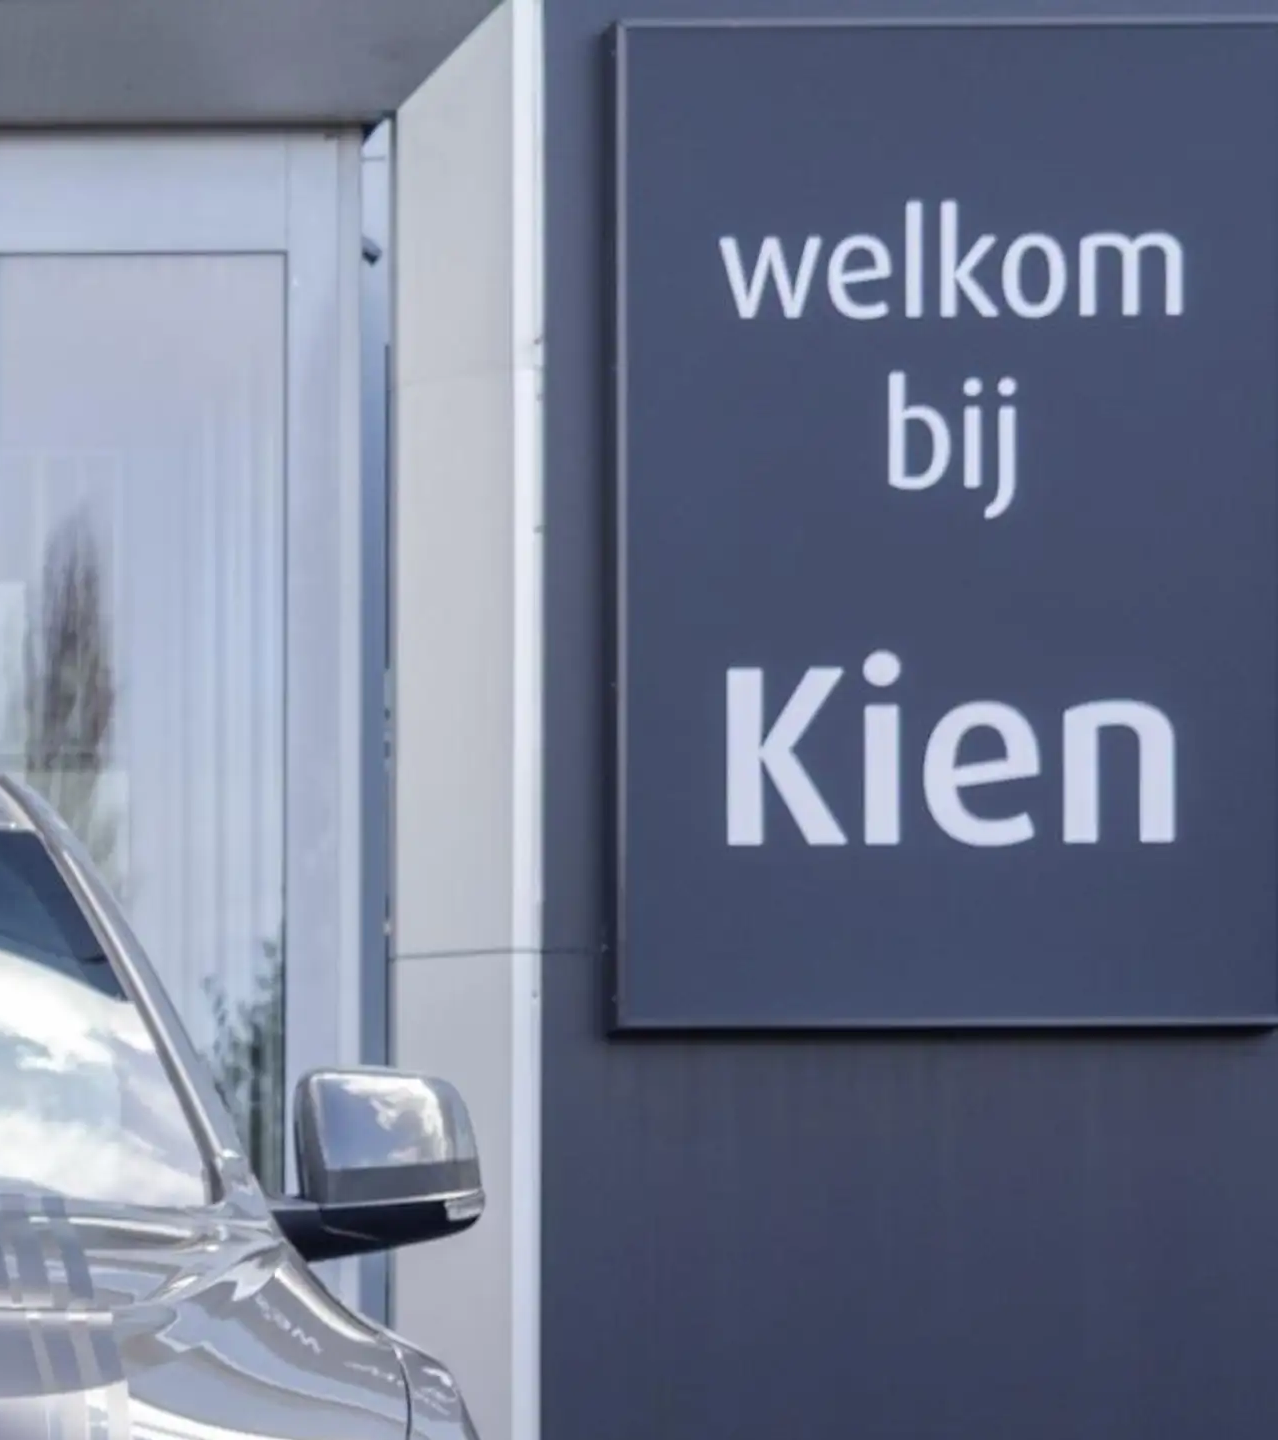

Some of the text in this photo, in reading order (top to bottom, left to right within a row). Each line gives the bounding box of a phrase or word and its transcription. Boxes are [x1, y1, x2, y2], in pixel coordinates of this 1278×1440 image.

[719, 200, 1183, 320] welkom
[888, 371, 1017, 519] bij
[726, 651, 1175, 847] Kien
